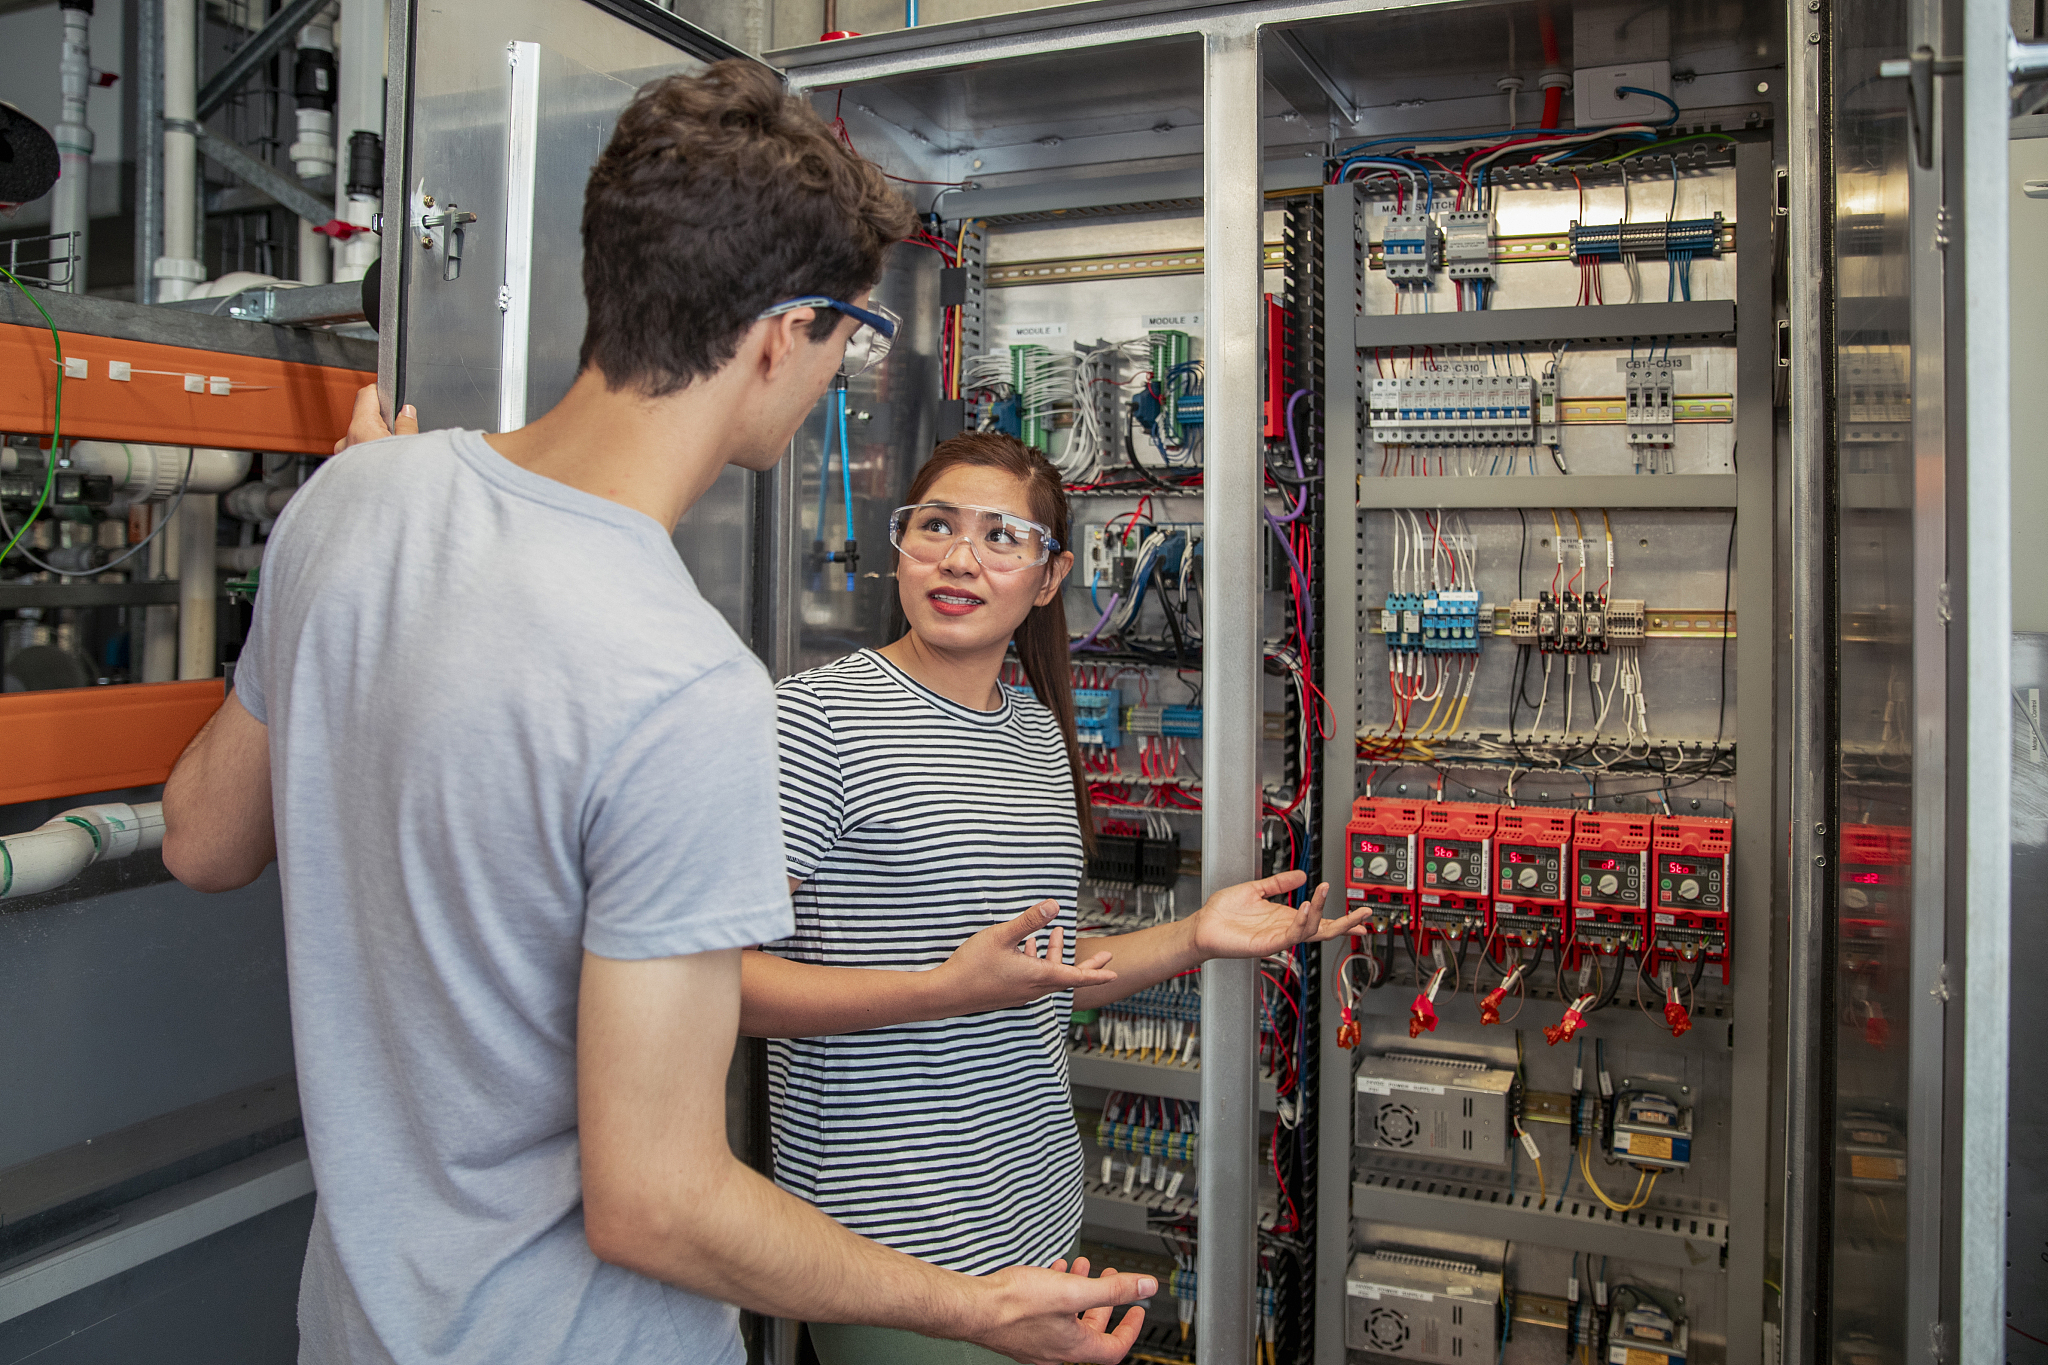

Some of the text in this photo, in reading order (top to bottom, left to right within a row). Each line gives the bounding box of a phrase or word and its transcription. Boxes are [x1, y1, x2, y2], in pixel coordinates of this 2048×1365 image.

[1381, 204, 1407, 213] MAN
[1149, 315, 1199, 325] MODULE 2
[1016, 326, 1062, 336] MODULE 1
